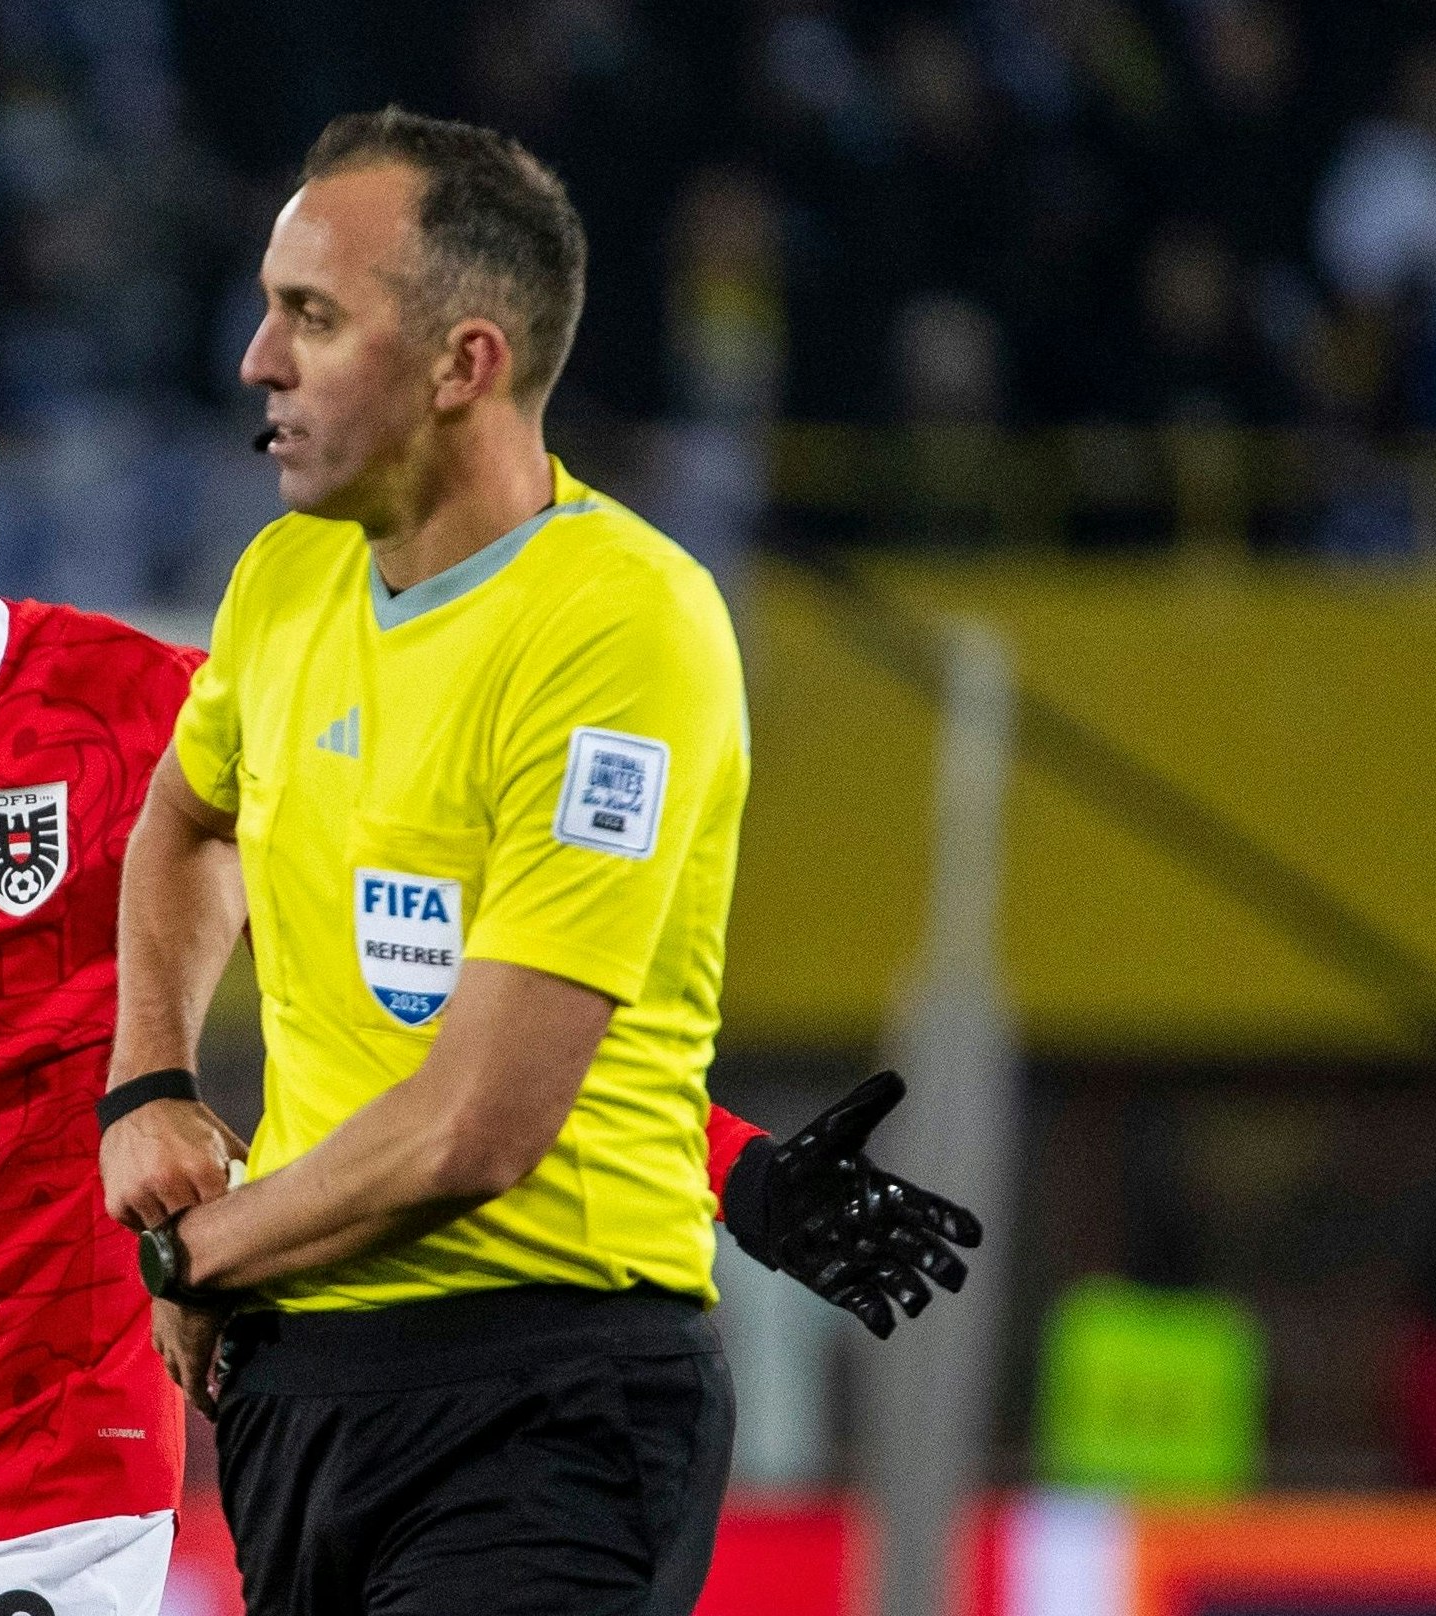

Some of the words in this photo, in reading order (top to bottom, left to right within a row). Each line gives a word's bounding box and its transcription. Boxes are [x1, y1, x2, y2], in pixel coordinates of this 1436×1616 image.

[364, 878, 449, 923] FIFA
[366, 939, 453, 966] REFEREE
[389, 993, 431, 1012] 2025
